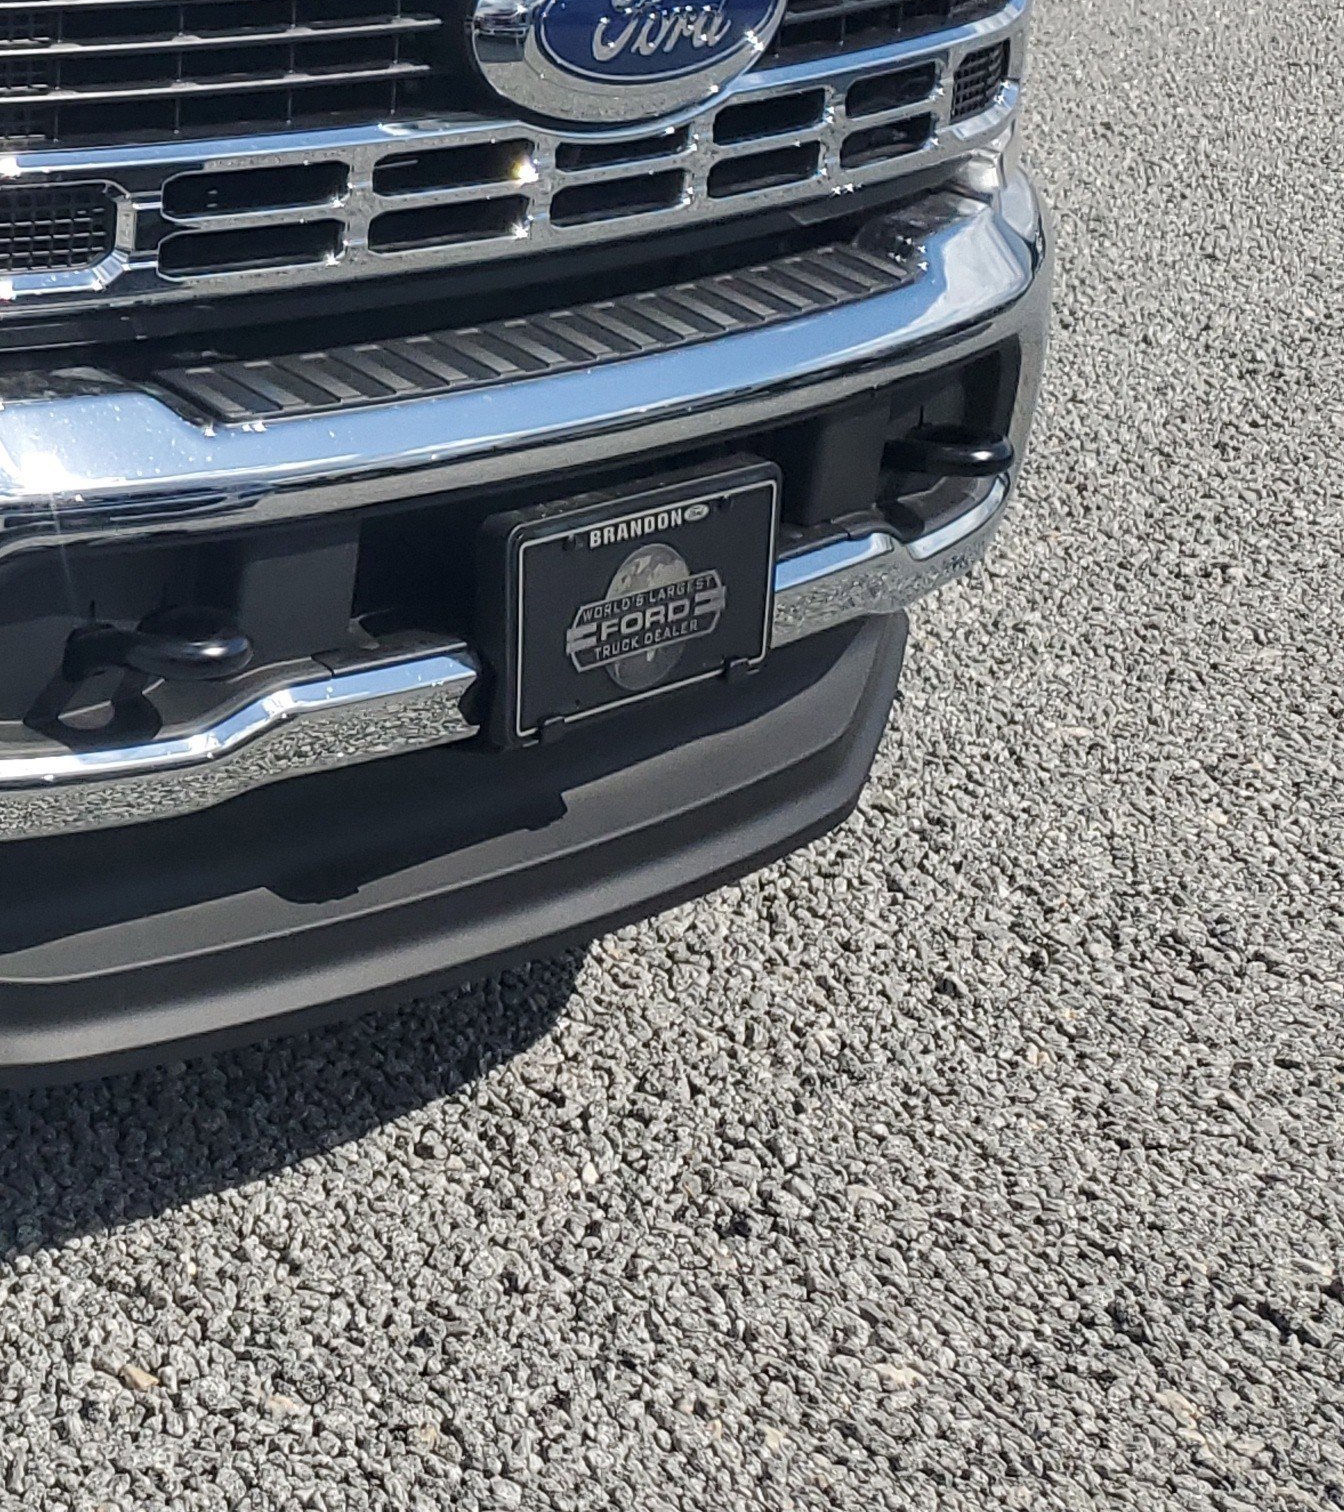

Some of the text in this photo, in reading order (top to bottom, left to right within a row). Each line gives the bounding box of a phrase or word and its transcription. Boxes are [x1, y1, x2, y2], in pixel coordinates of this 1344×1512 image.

[589, 508, 682, 549] BRANDON
[582, 576, 713, 623] WORLD'S LARGEST
[600, 598, 691, 641] FORD
[594, 619, 698, 661] TRUCK DEALER
